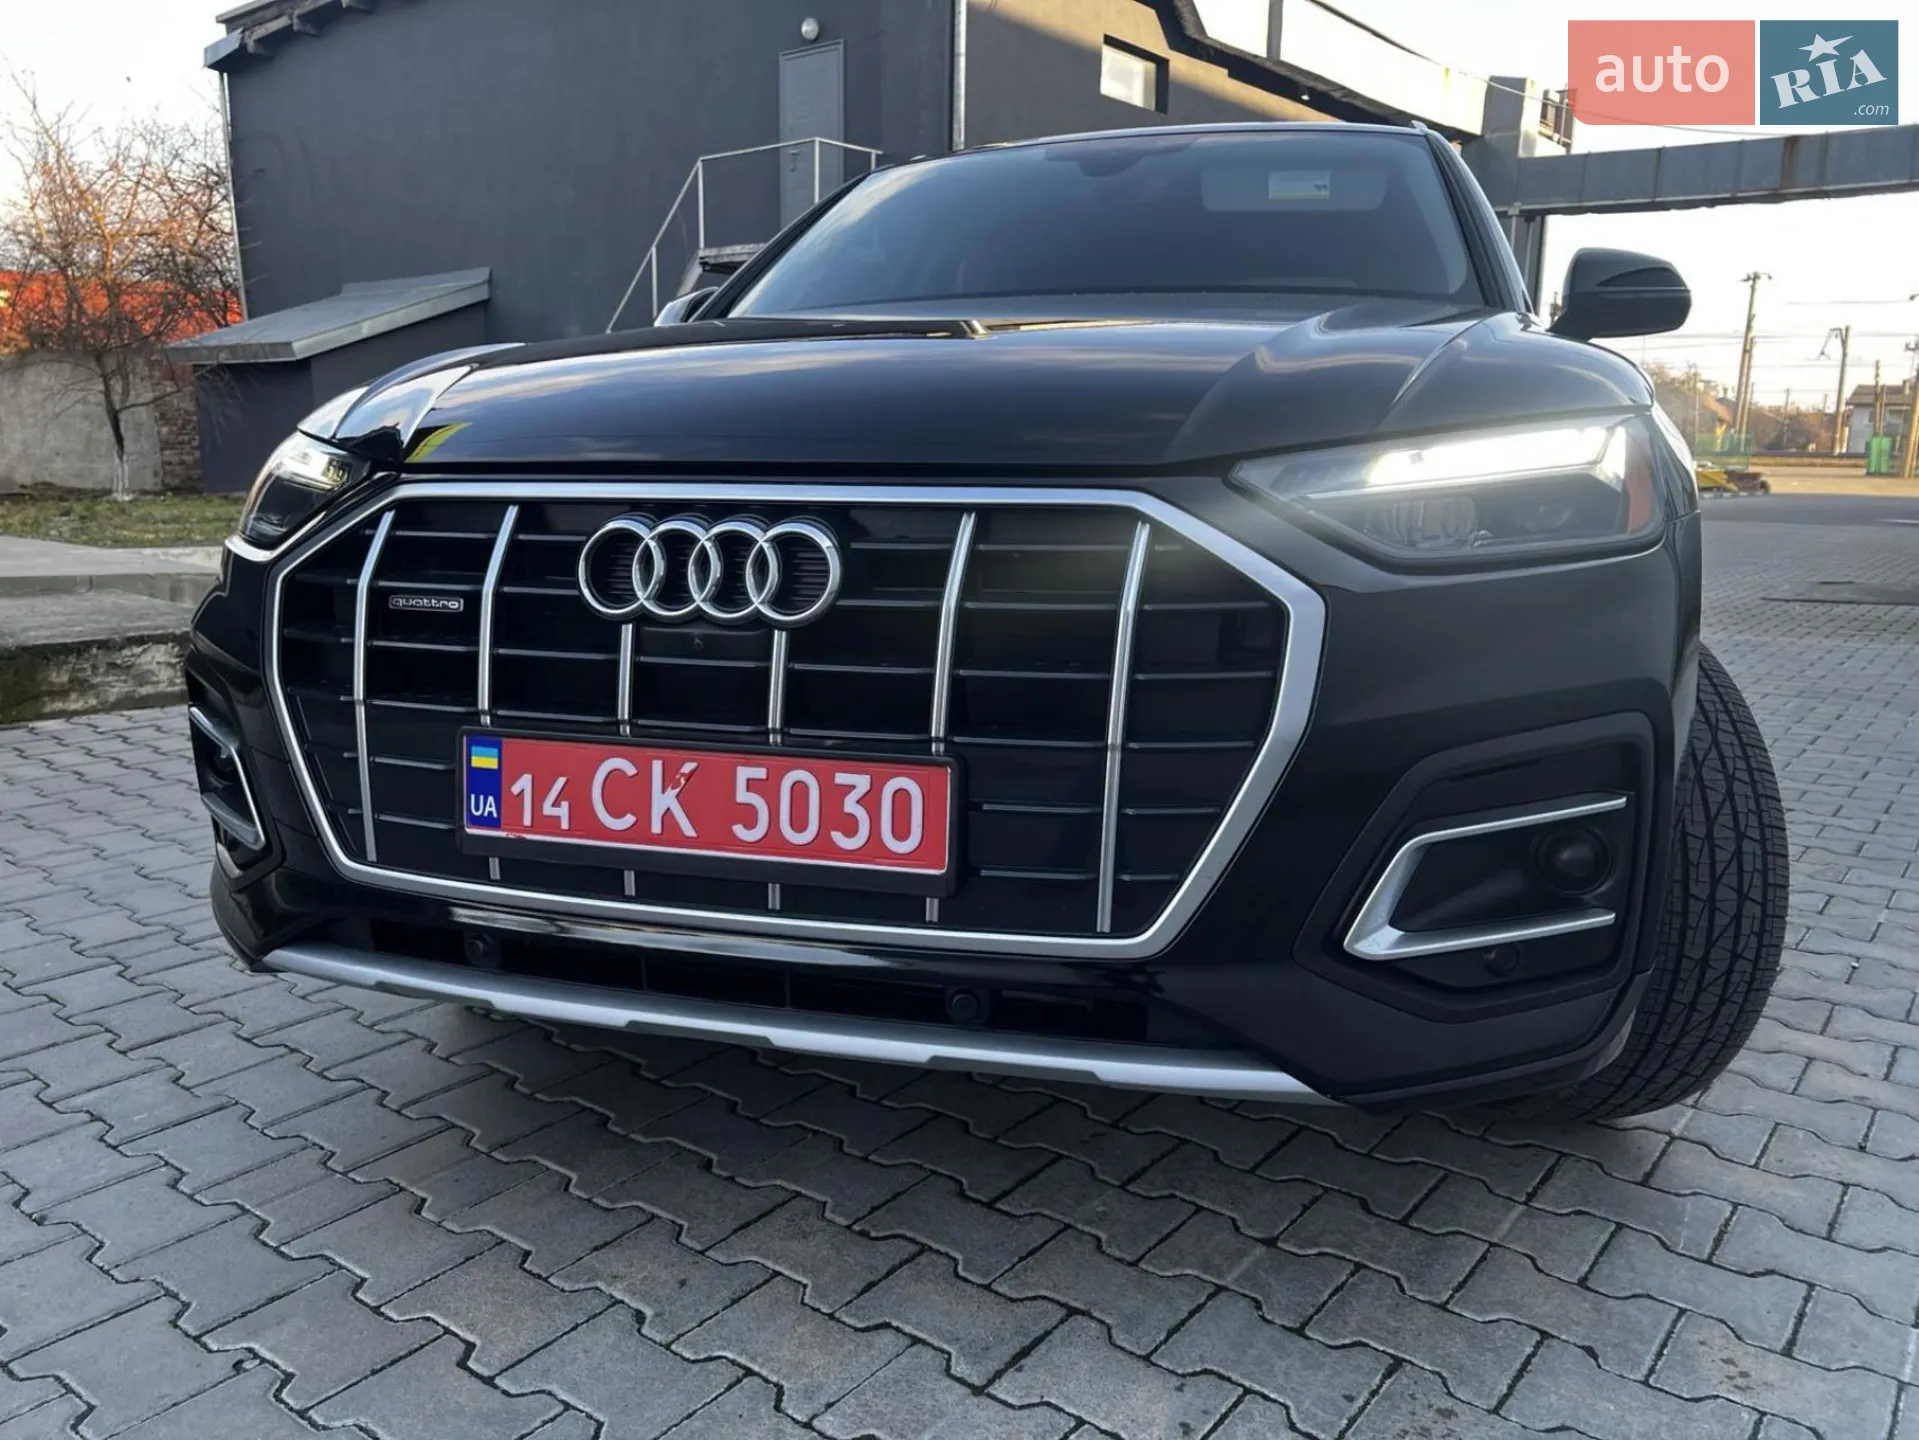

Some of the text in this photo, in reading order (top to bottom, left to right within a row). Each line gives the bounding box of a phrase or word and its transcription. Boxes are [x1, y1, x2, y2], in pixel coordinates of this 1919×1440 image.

[392, 597, 459, 609] quattro
[470, 793, 498, 818] UA
[510, 757, 924, 854] 14 CK 5030
